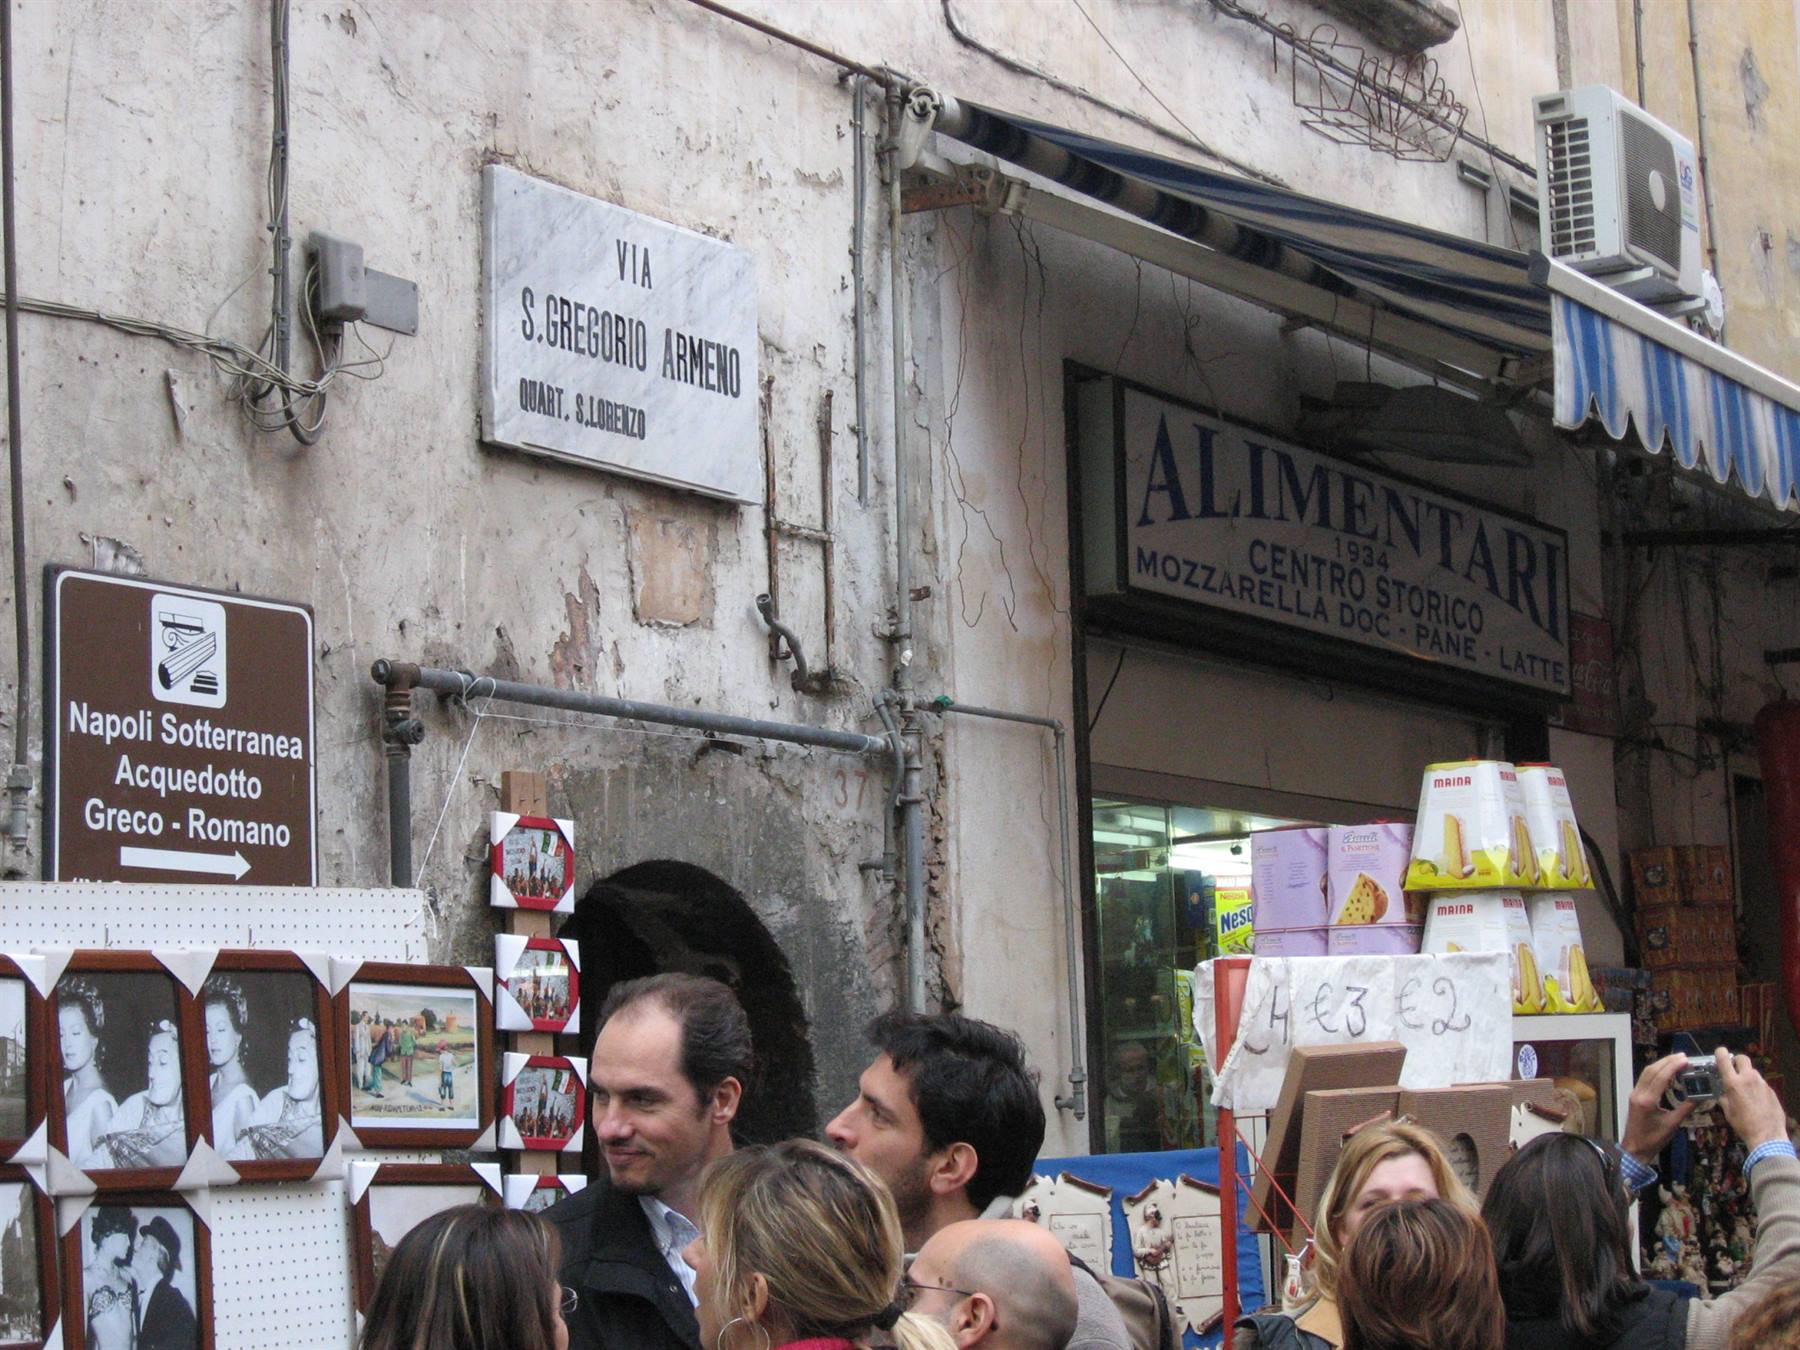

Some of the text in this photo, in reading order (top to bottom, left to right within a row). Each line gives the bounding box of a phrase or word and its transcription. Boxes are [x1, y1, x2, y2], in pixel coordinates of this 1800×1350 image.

[615, 238, 652, 290] VIA
[521, 286, 741, 399] S.GREGORIO ARMENO
[519, 377, 646, 441] QUART. S.LORENZO
[1135, 410, 1565, 647] ALIMENTARI
[1334, 536, 1390, 573] 1934
[1248, 538, 1484, 635] CENTRO STORICO
[1135, 546, 1329, 624] MOZZARELLA
[1339, 602, 1391, 638] DOC
[1415, 622, 1477, 662] PANE
[1500, 646, 1565, 687] LATTE
[68, 700, 304, 761] Napoli Sotterranea
[114, 754, 263, 801] Acquedotto
[1433, 776, 1472, 788] MAINA
[84, 797, 164, 836] Greco
[188, 807, 291, 848] Romano
[1437, 904, 1473, 917] MAINA
